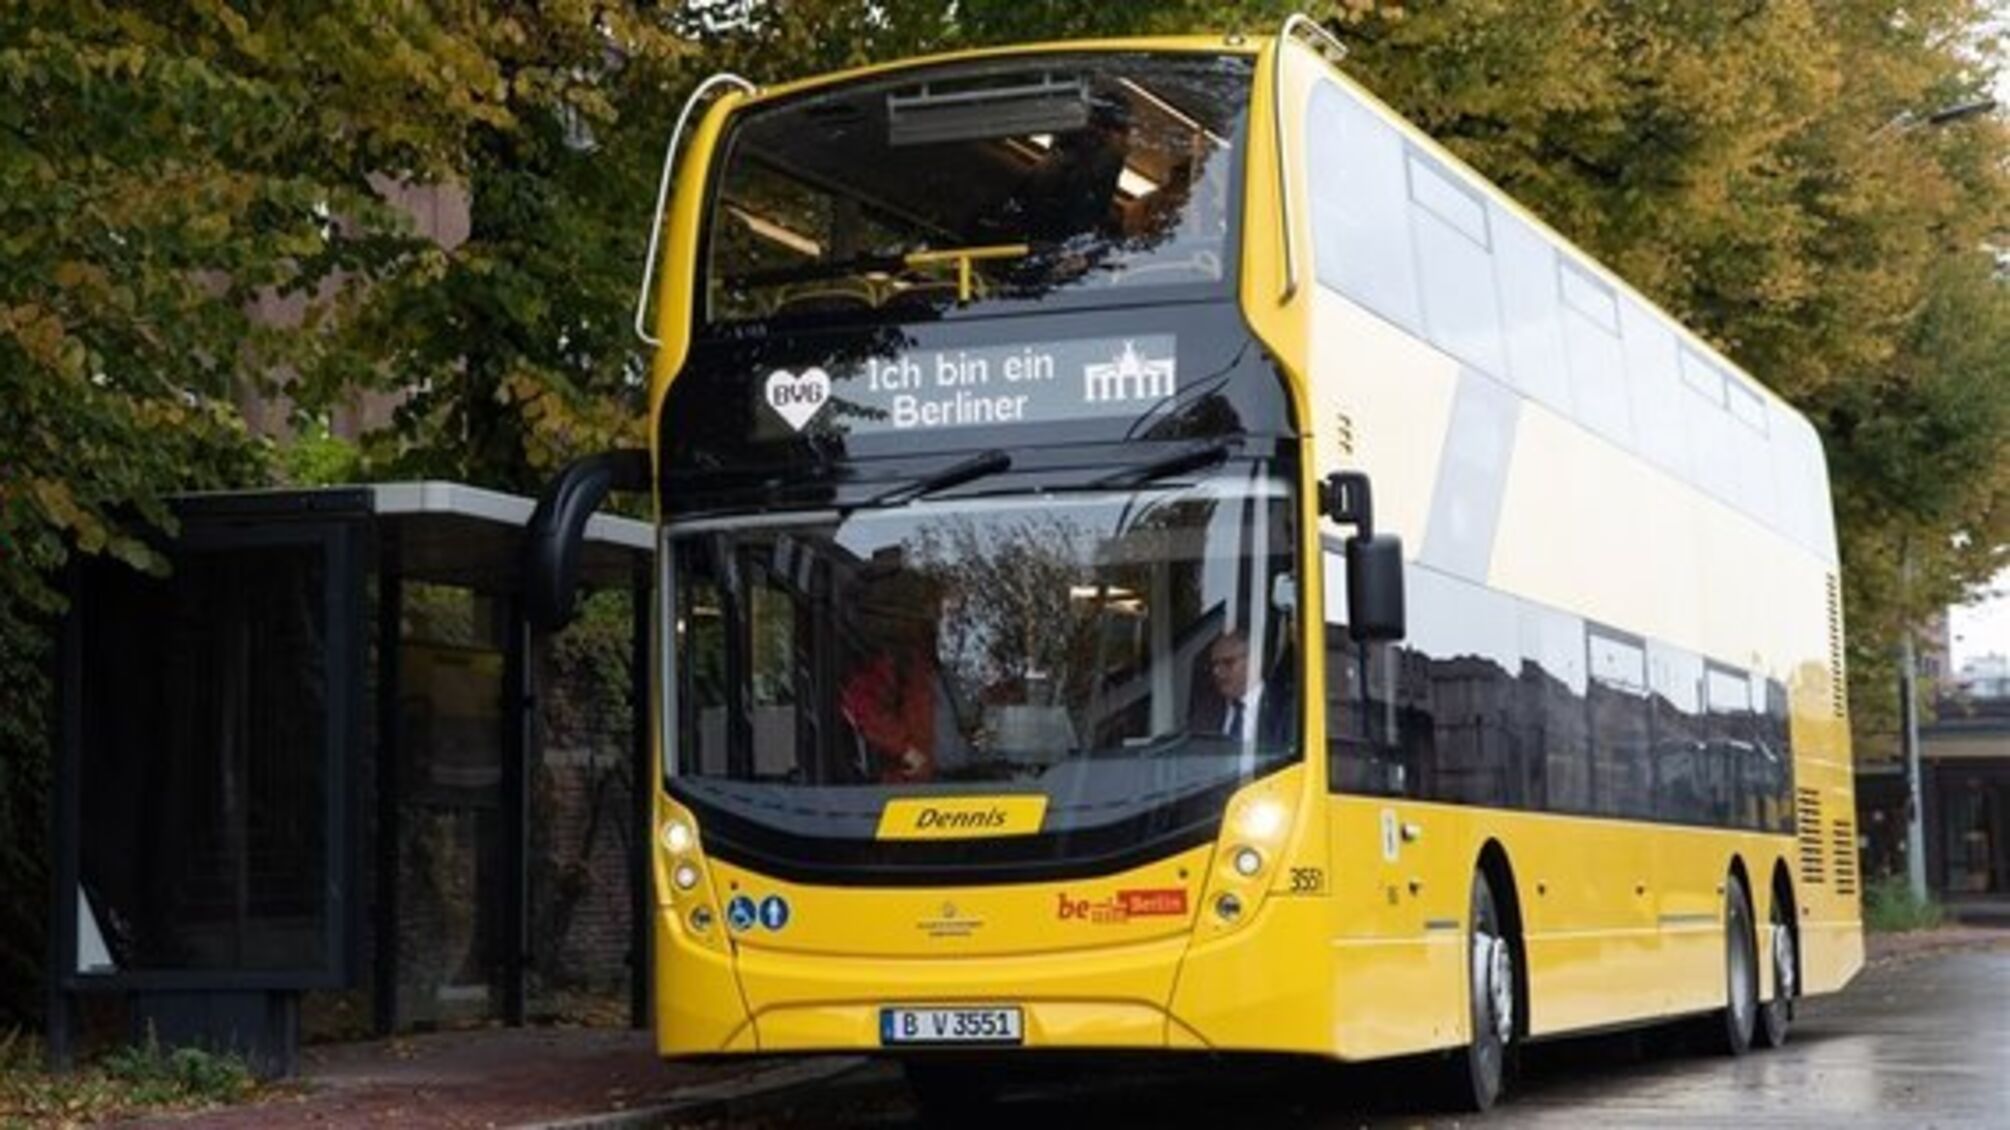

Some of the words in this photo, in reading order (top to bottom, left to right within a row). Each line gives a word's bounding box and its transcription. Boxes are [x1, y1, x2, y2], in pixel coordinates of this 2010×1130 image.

[868, 356, 921, 391] Ich
[936, 352, 989, 386] bin
[1003, 347, 1054, 381] ein
[773, 382, 823, 406] BVG
[893, 390, 1028, 429] Berliner
[917, 808, 1007, 828] Dennis
[1058, 893, 1089, 920] be
[904, 1012, 918, 1036] B
